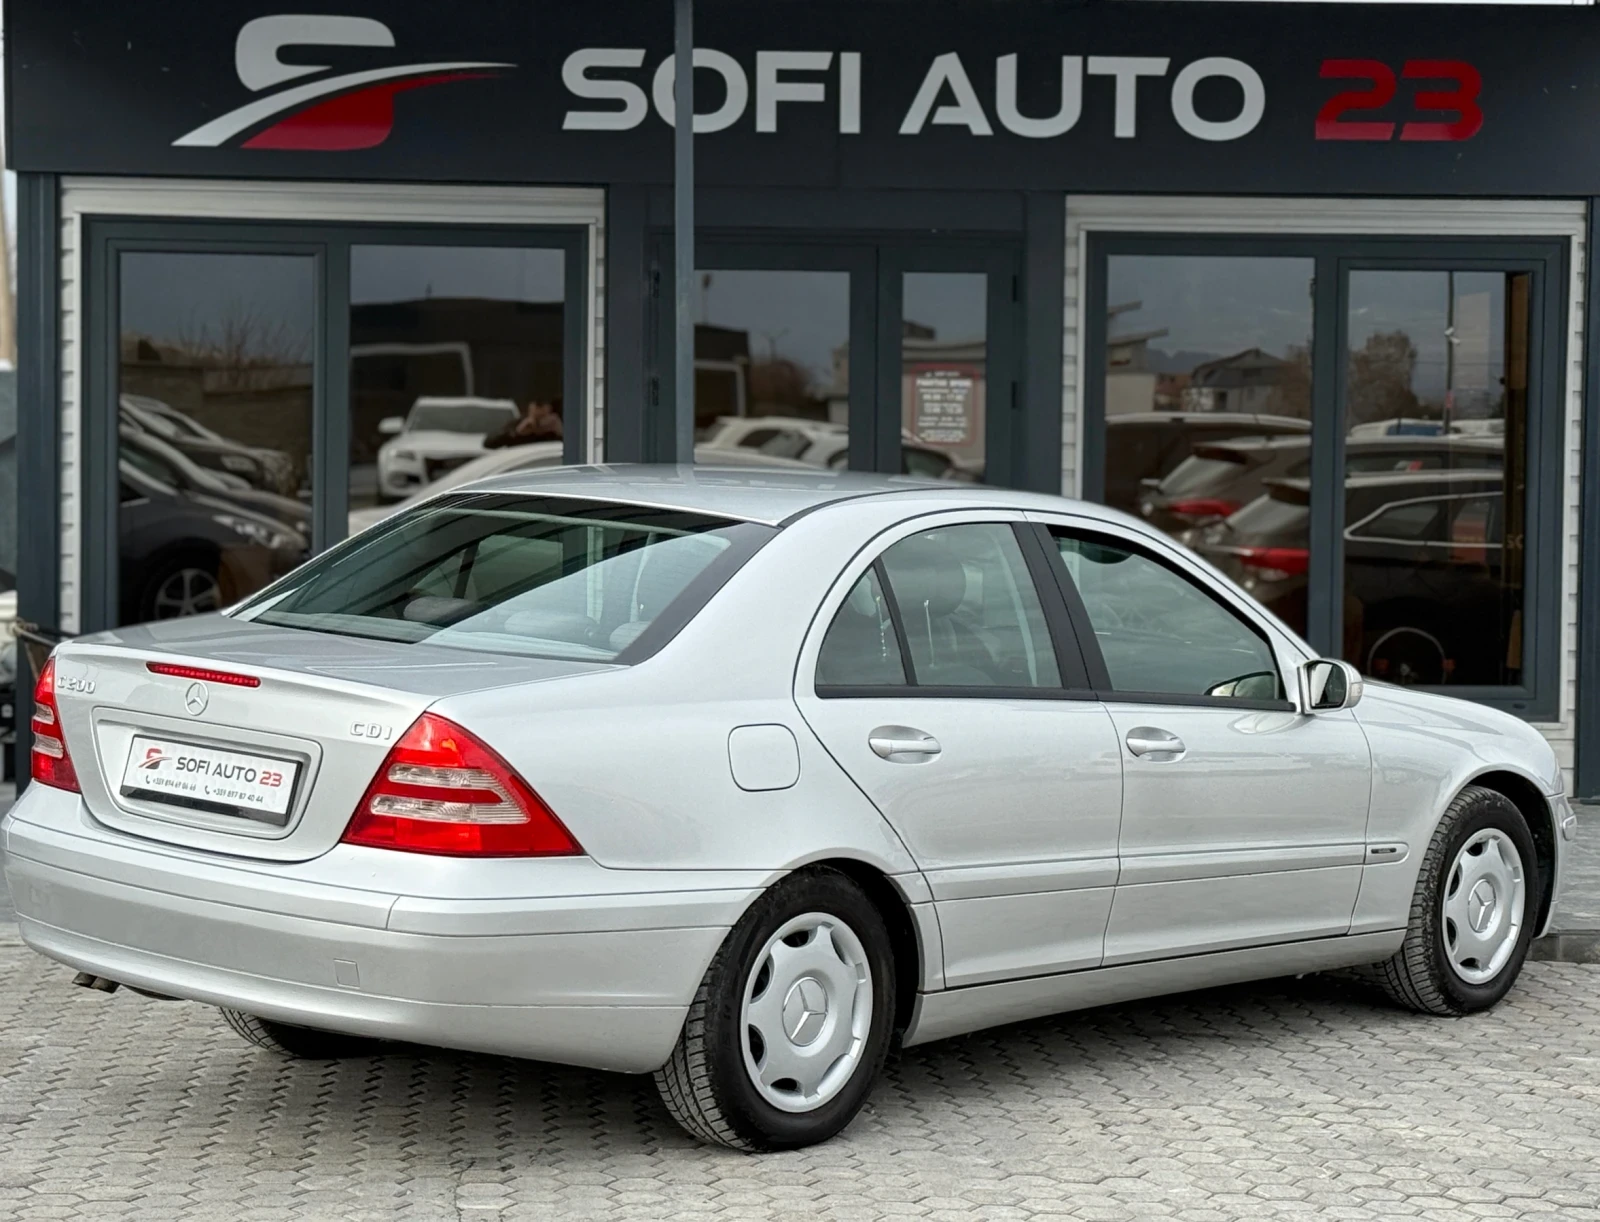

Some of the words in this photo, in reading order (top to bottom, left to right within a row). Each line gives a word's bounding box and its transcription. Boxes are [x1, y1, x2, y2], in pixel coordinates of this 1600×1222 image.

[562, 48, 861, 134] SOFI
[899, 51, 1266, 141] AUTO
[1315, 59, 1484, 141] 23
[350, 721, 393, 740] CDI
[175, 756, 210, 775] SOFI
[212, 763, 257, 783] AUTO
[259, 770, 283, 788] 23
